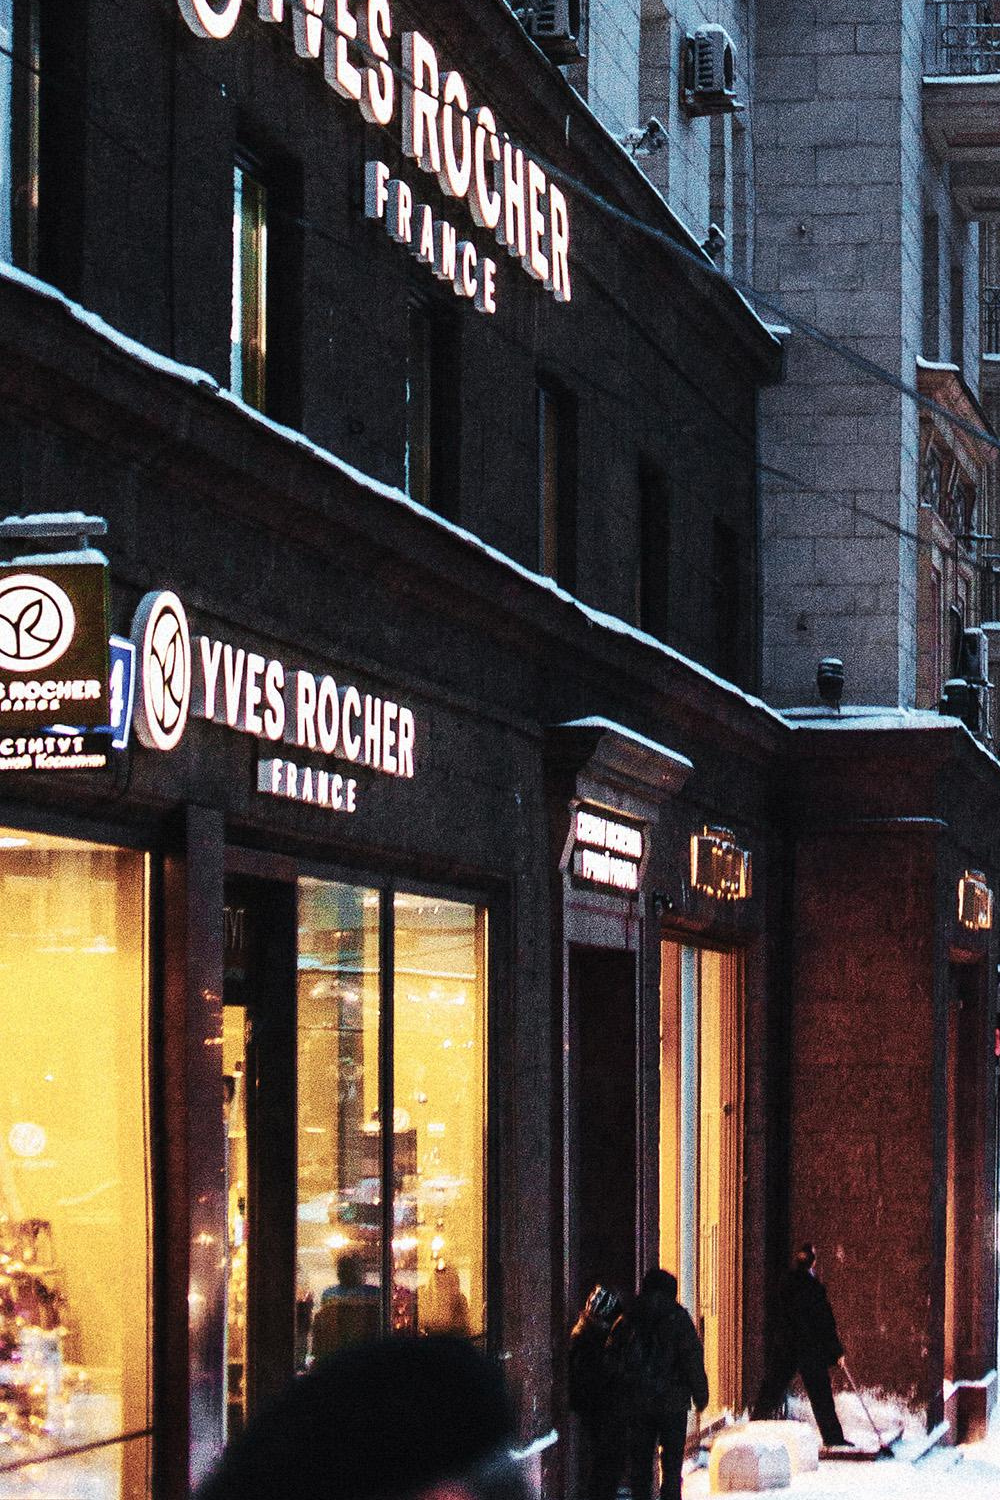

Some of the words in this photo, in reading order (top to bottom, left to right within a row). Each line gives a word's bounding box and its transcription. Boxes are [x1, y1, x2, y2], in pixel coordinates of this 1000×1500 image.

[376, 159, 497, 314] FRANCE
[411, 30, 573, 302] ROCHER
[8, 679, 102, 701] ROCHER
[200, 635, 286, 742] YVES
[296, 669, 415, 779] ROCHER
[271, 757, 358, 813] FRANCE
